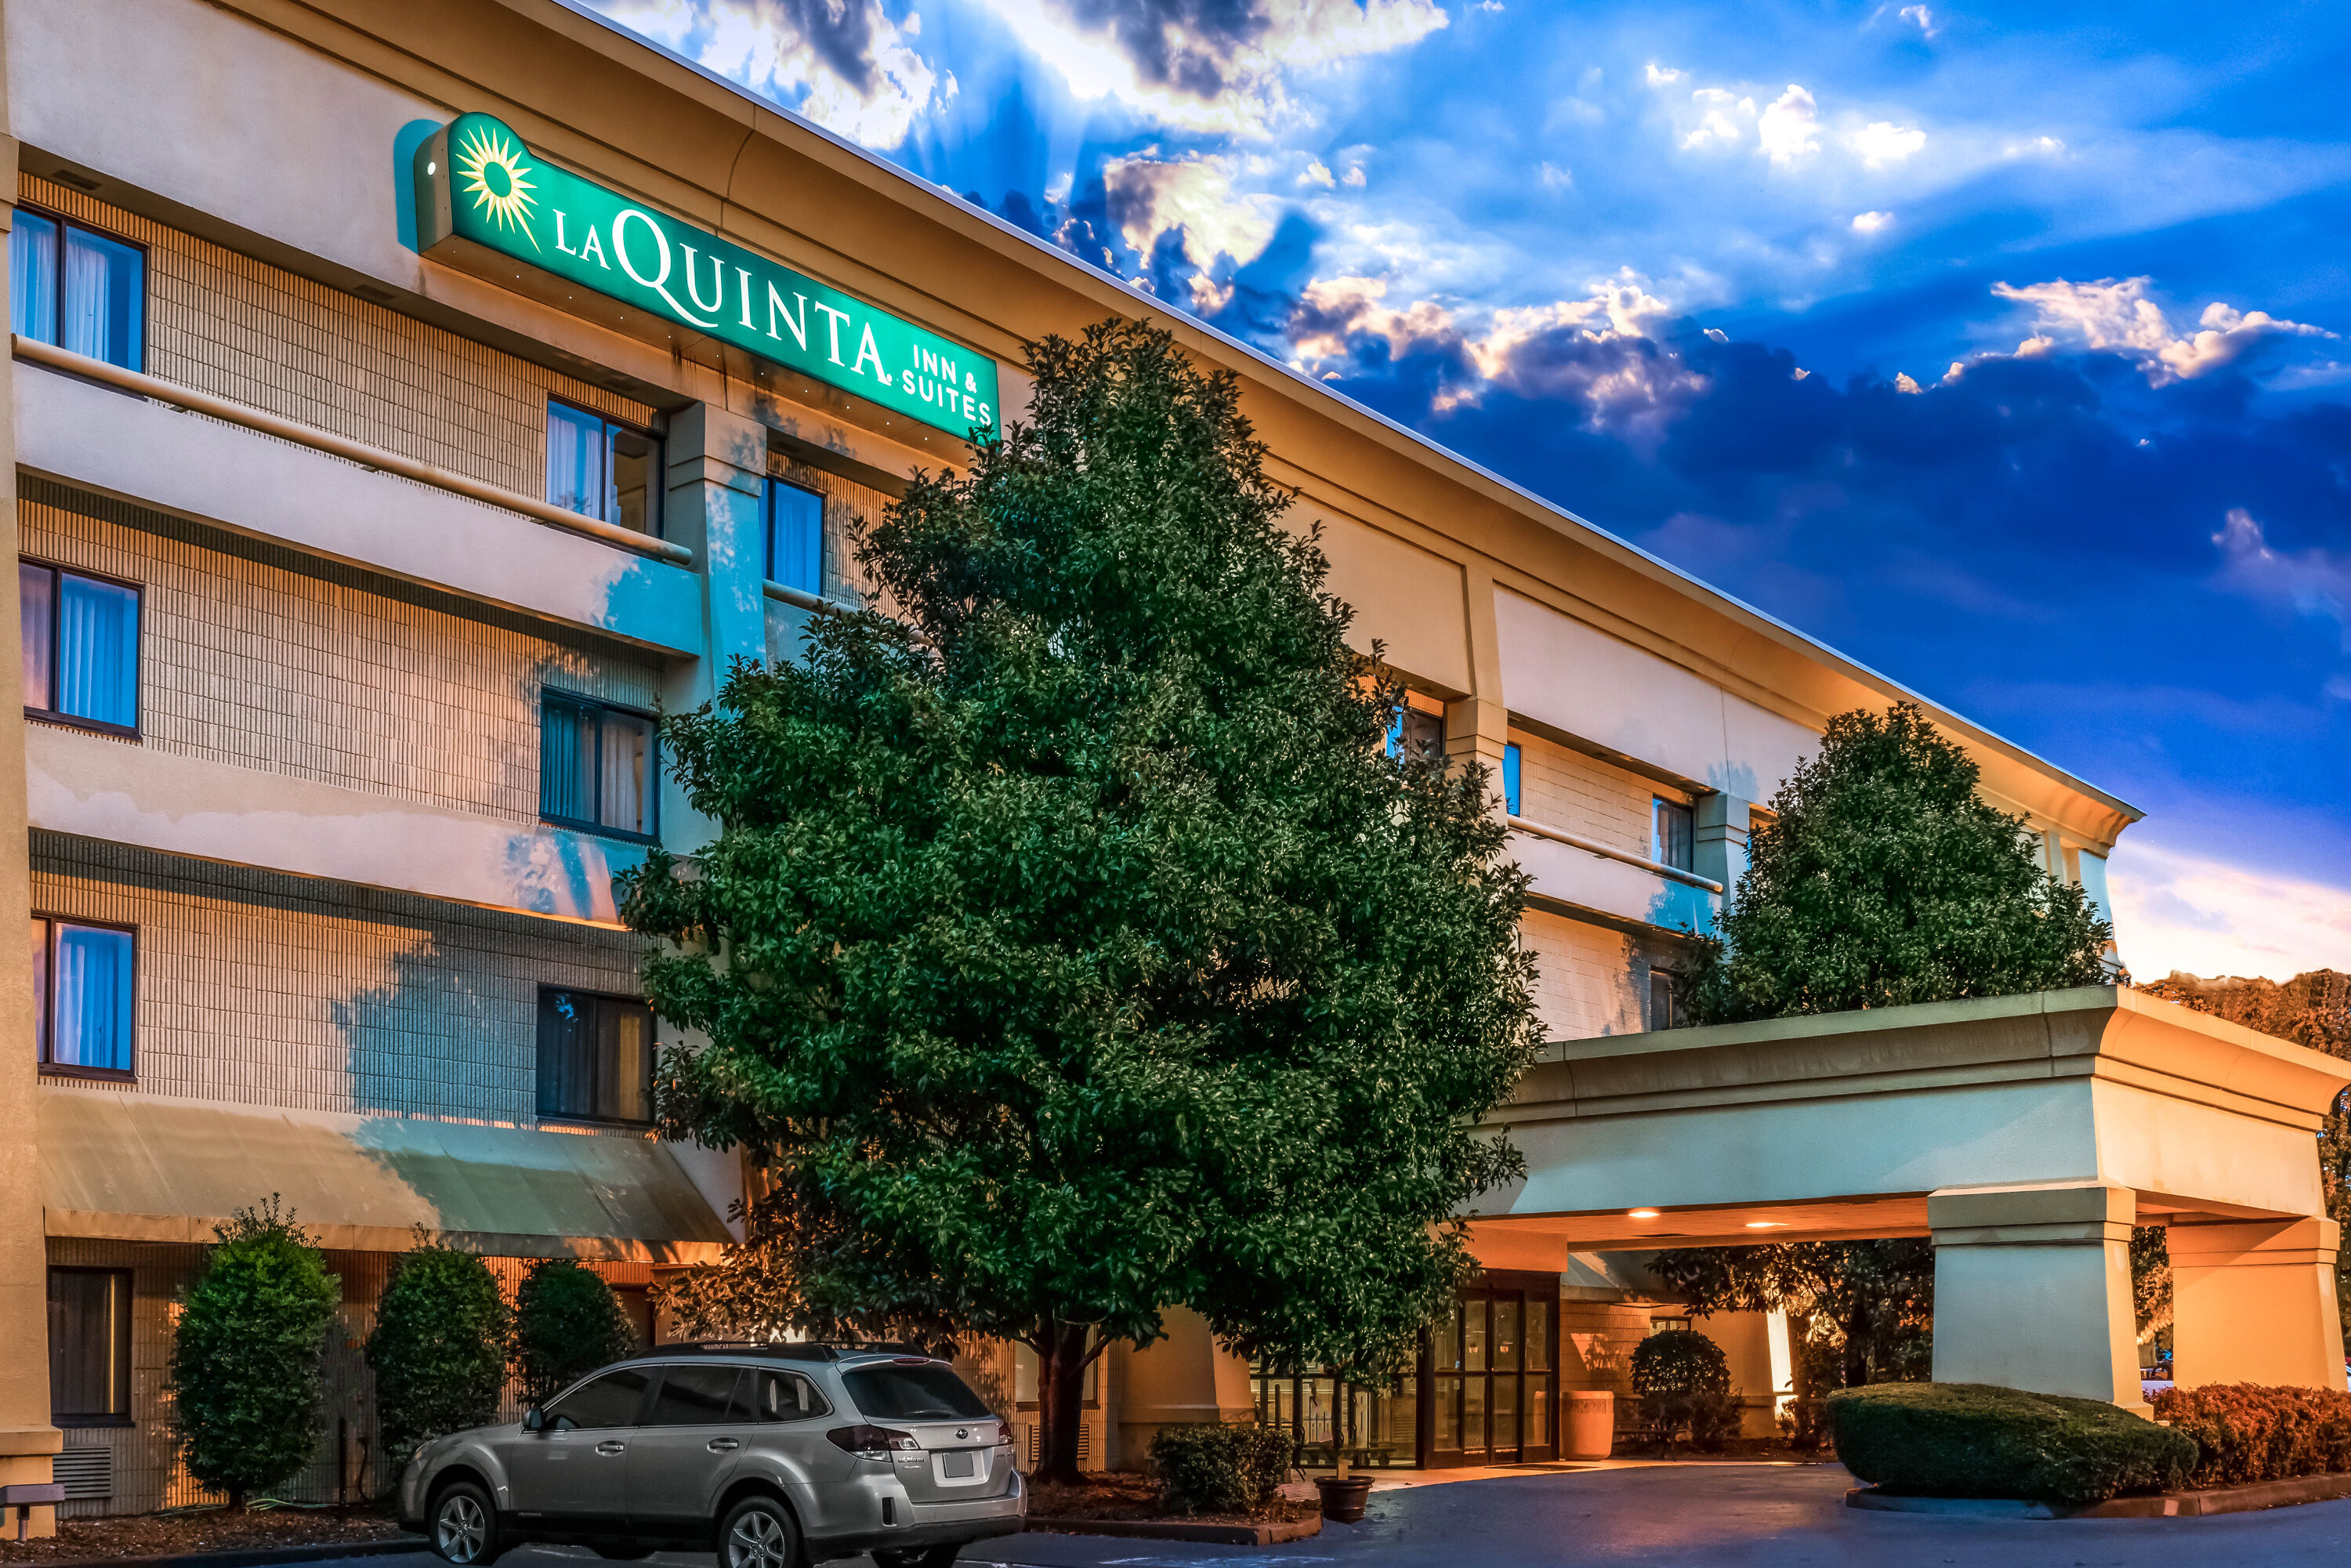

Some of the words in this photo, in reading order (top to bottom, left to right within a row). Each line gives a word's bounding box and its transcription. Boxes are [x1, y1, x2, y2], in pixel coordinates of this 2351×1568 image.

[552, 208, 611, 270] LA
[612, 208, 892, 386] QUINTA
[914, 344, 956, 385] INN
[965, 371, 977, 393] &
[902, 369, 991, 426] SUITES
